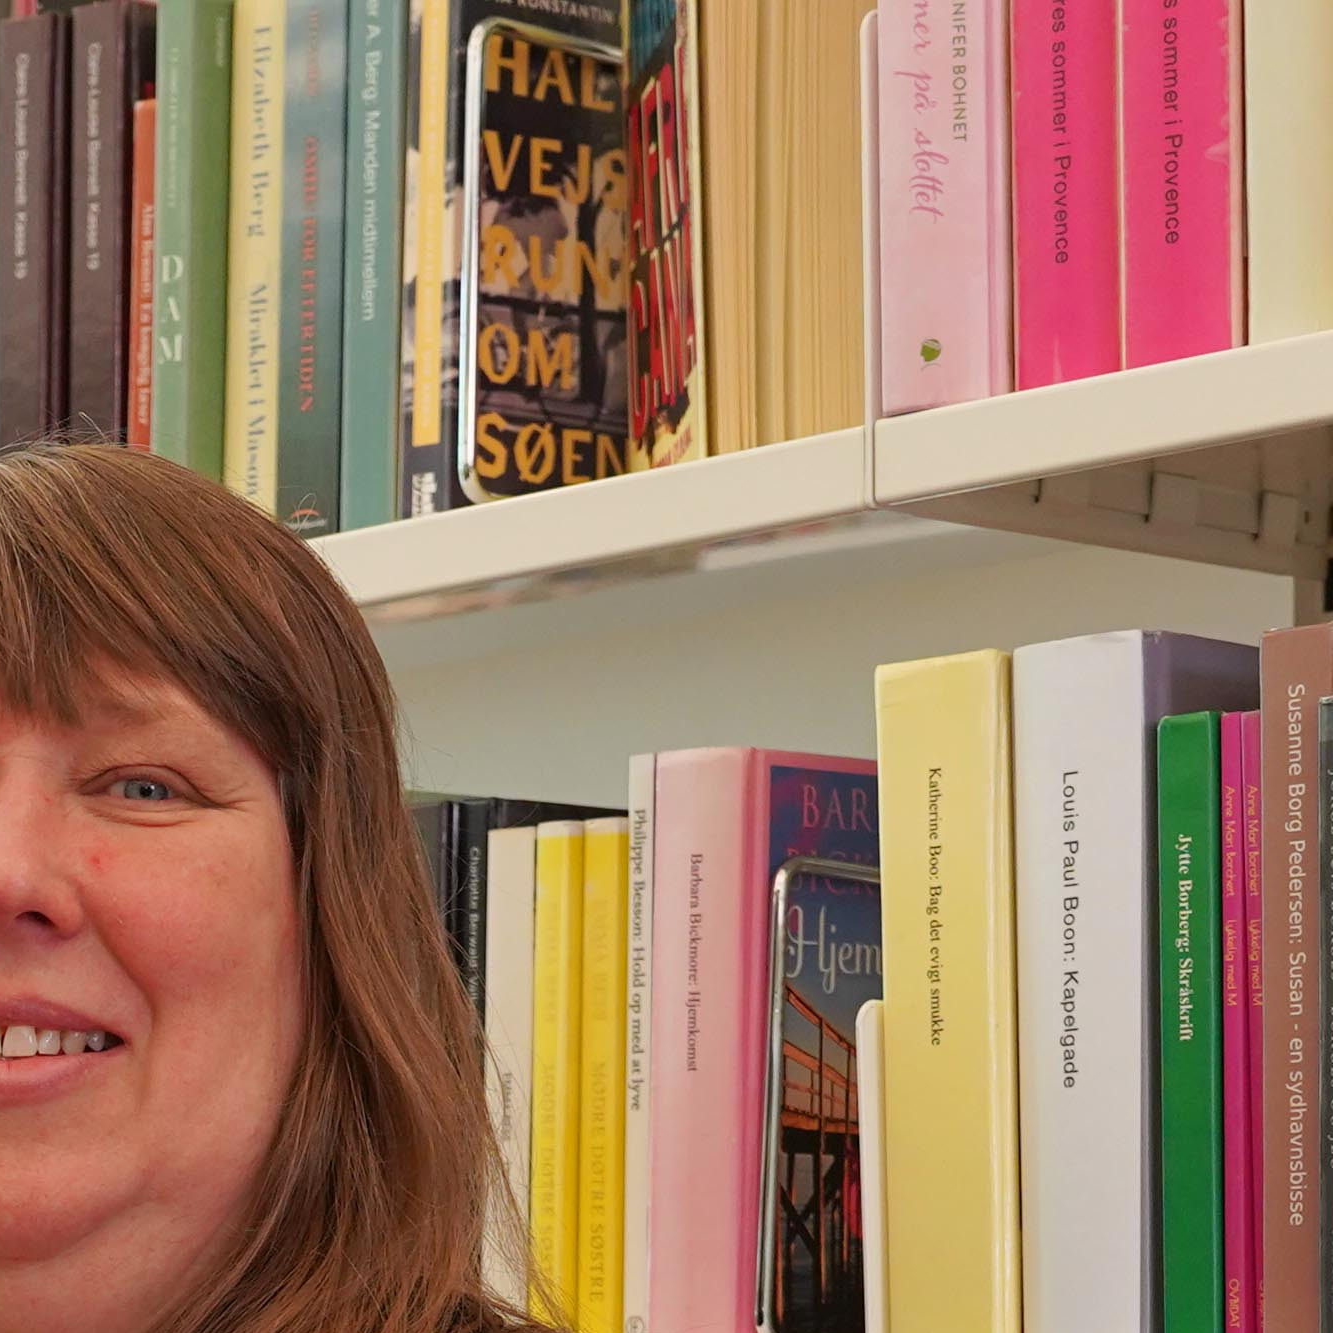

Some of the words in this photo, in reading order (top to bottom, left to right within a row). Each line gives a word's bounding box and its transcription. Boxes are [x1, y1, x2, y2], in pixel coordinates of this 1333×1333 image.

[252, 26, 272, 161] Elizabeth
[485, 33, 615, 113] HAL
[894, 71, 939, 115] på
[1052, 41, 1067, 133] sommer
[1164, 17, 1178, 111] sommer
[952, 65, 968, 142] BOHNET
[364, 110, 381, 193] Manden
[483, 129, 629, 209] VEJS
[908, 128, 950, 224] slottet
[247, 171, 271, 238] Berg
[1052, 155, 1071, 264] Provence
[1164, 134, 1184, 244] Provence
[360, 199, 379, 321] midtimellem
[478, 322, 576, 390] OM
[475, 410, 631, 484] SØEN
[1286, 684, 1306, 776] Susanne
[928, 767, 942, 840] Katherine
[1062, 770, 1079, 832] Louis
[1284, 783, 1306, 832] Borg
[630, 809, 648, 874] Philippe
[928, 845, 942, 880] Boo:
[1062, 840, 1079, 887] Paul
[1176, 833, 1193, 874] Jytte
[632, 881, 647, 941] Besson:
[689, 853, 704, 909] Barbara
[926, 885, 943, 915] Bag
[1287, 840, 1307, 944] Pedersen:
[688, 912, 703, 985] Bickmore:
[931, 920, 944, 942] det
[1062, 896, 1079, 962] Boon:
[1175, 879, 1193, 953] Borberg:
[632, 947, 646, 987] Hold
[926, 947, 944, 984] evigt
[1226, 965, 1238, 990] med
[1251, 965, 1262, 990] med
[1288, 951, 1307, 1016] Susan
[628, 993, 643, 1014] op
[684, 991, 702, 1071] Hjemkomst
[930, 988, 945, 1046] smukke
[1060, 971, 1080, 1088] Kapelgade
[1177, 957, 1194, 1041] Skråskrift
[631, 1019, 646, 1054] med
[631, 1060, 643, 1075] at
[1288, 1037, 1303, 1064] en
[627, 1079, 646, 1112] lyve
[1285, 1070, 1309, 1226] sydhavnsbisse
